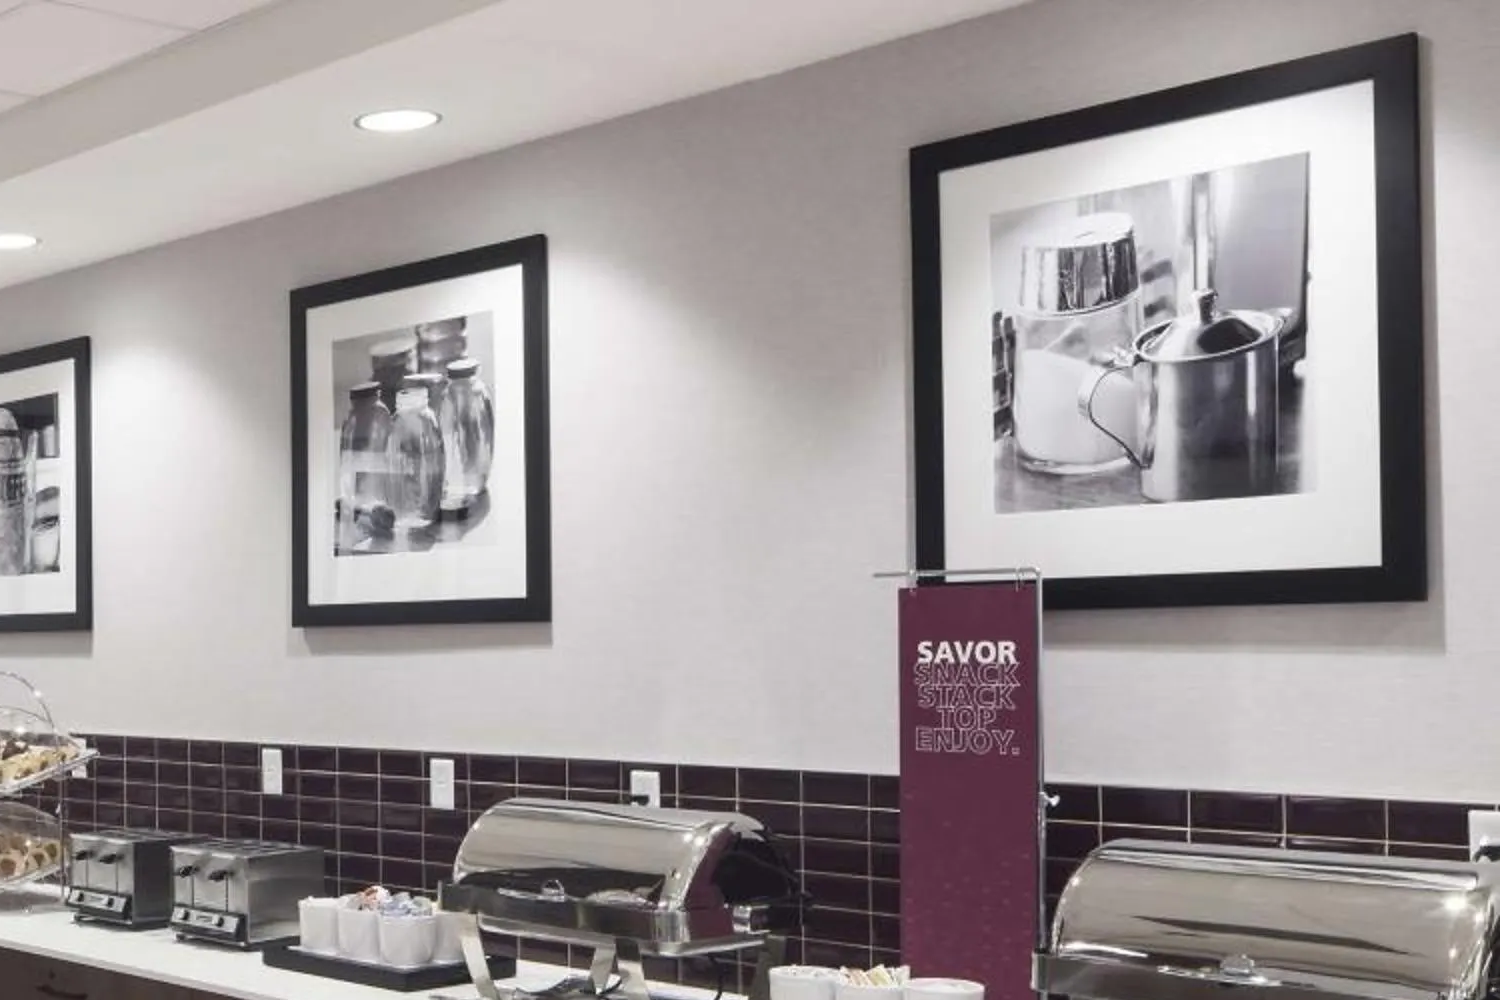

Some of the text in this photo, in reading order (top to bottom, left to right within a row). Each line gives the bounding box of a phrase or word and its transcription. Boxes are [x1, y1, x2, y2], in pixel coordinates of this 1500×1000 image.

[917, 640, 1017, 664] SAVOR
[913, 662, 1021, 687] SNACK
[917, 683, 1016, 711] STACK
[935, 705, 997, 731] TOP
[915, 726, 1021, 756] ENJOY.
